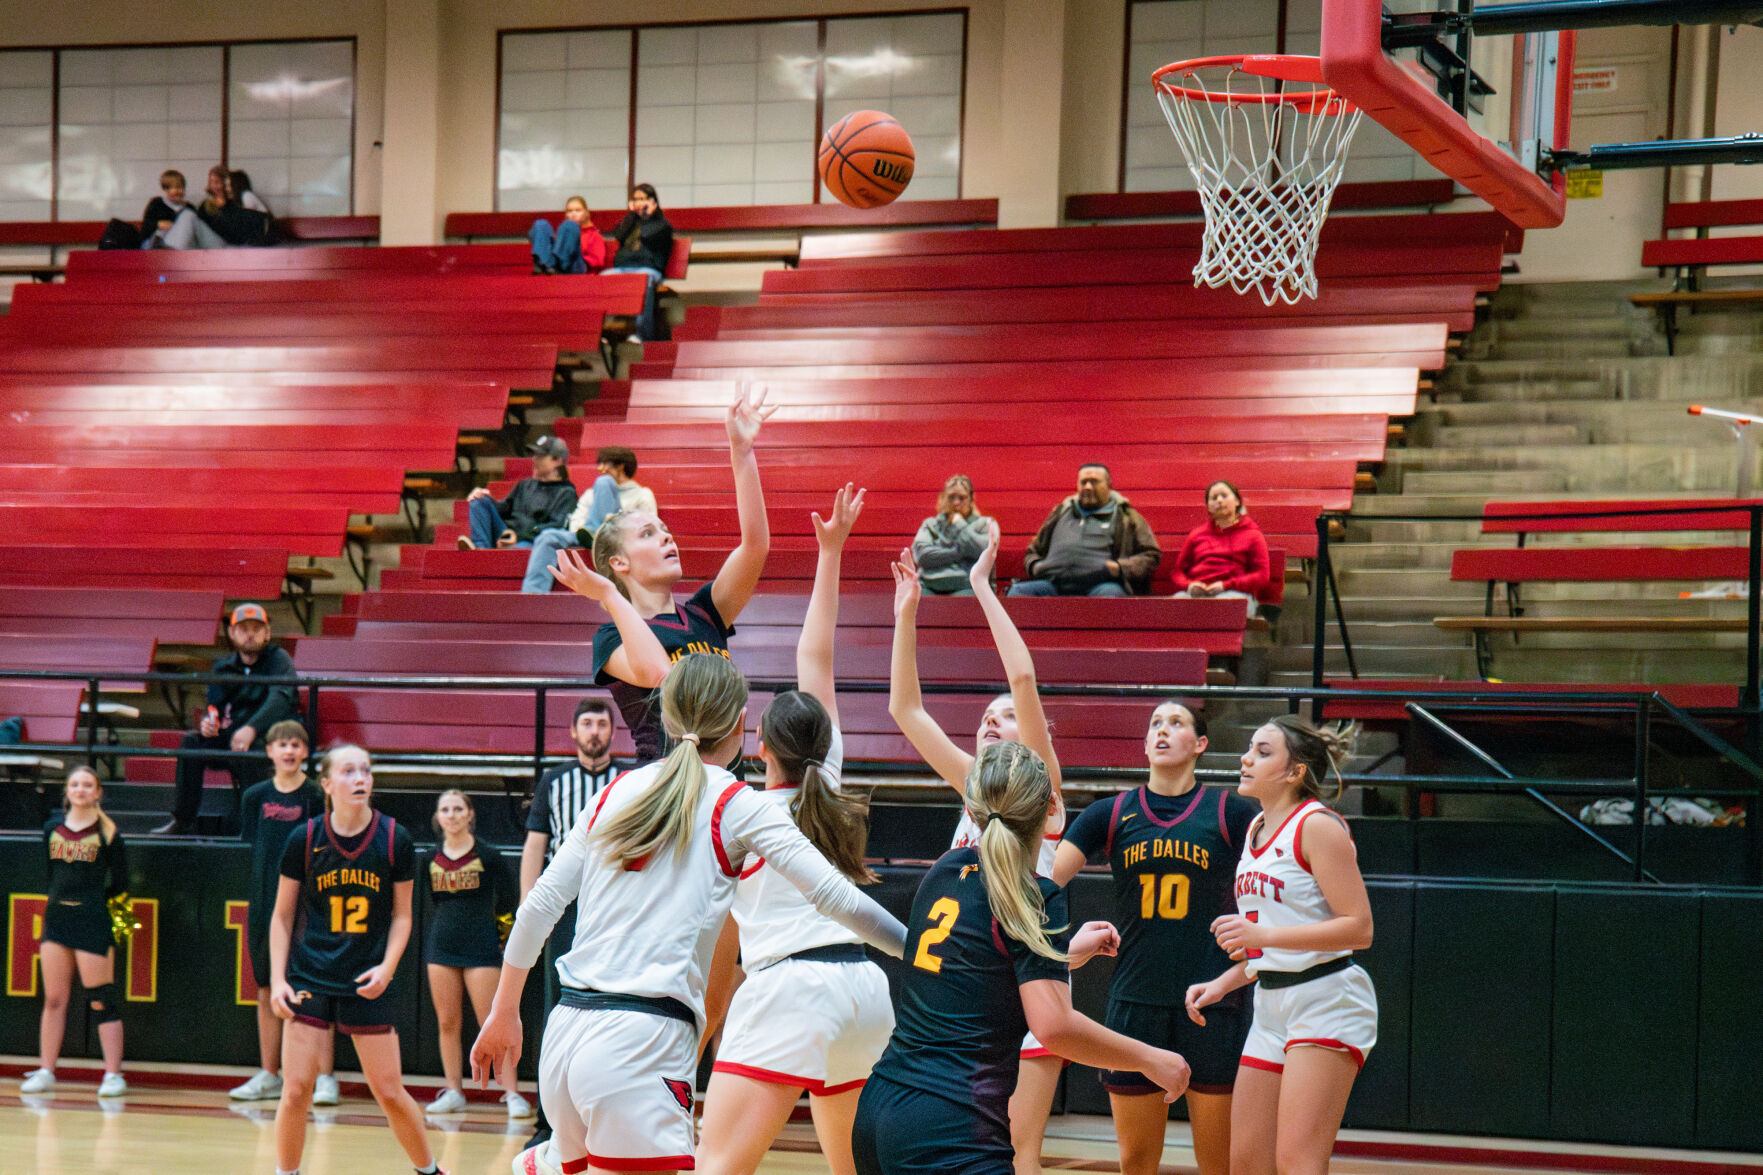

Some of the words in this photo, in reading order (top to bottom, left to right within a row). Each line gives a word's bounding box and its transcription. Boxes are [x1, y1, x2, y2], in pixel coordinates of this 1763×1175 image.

[1123, 841, 1148, 869] THE
[1153, 838, 1209, 870] DALLES
[317, 869, 338, 892] THE
[1138, 873, 1190, 920] 10
[1234, 871, 1285, 904] RBETT
[329, 895, 369, 933] 12
[913, 896, 960, 974] 2
